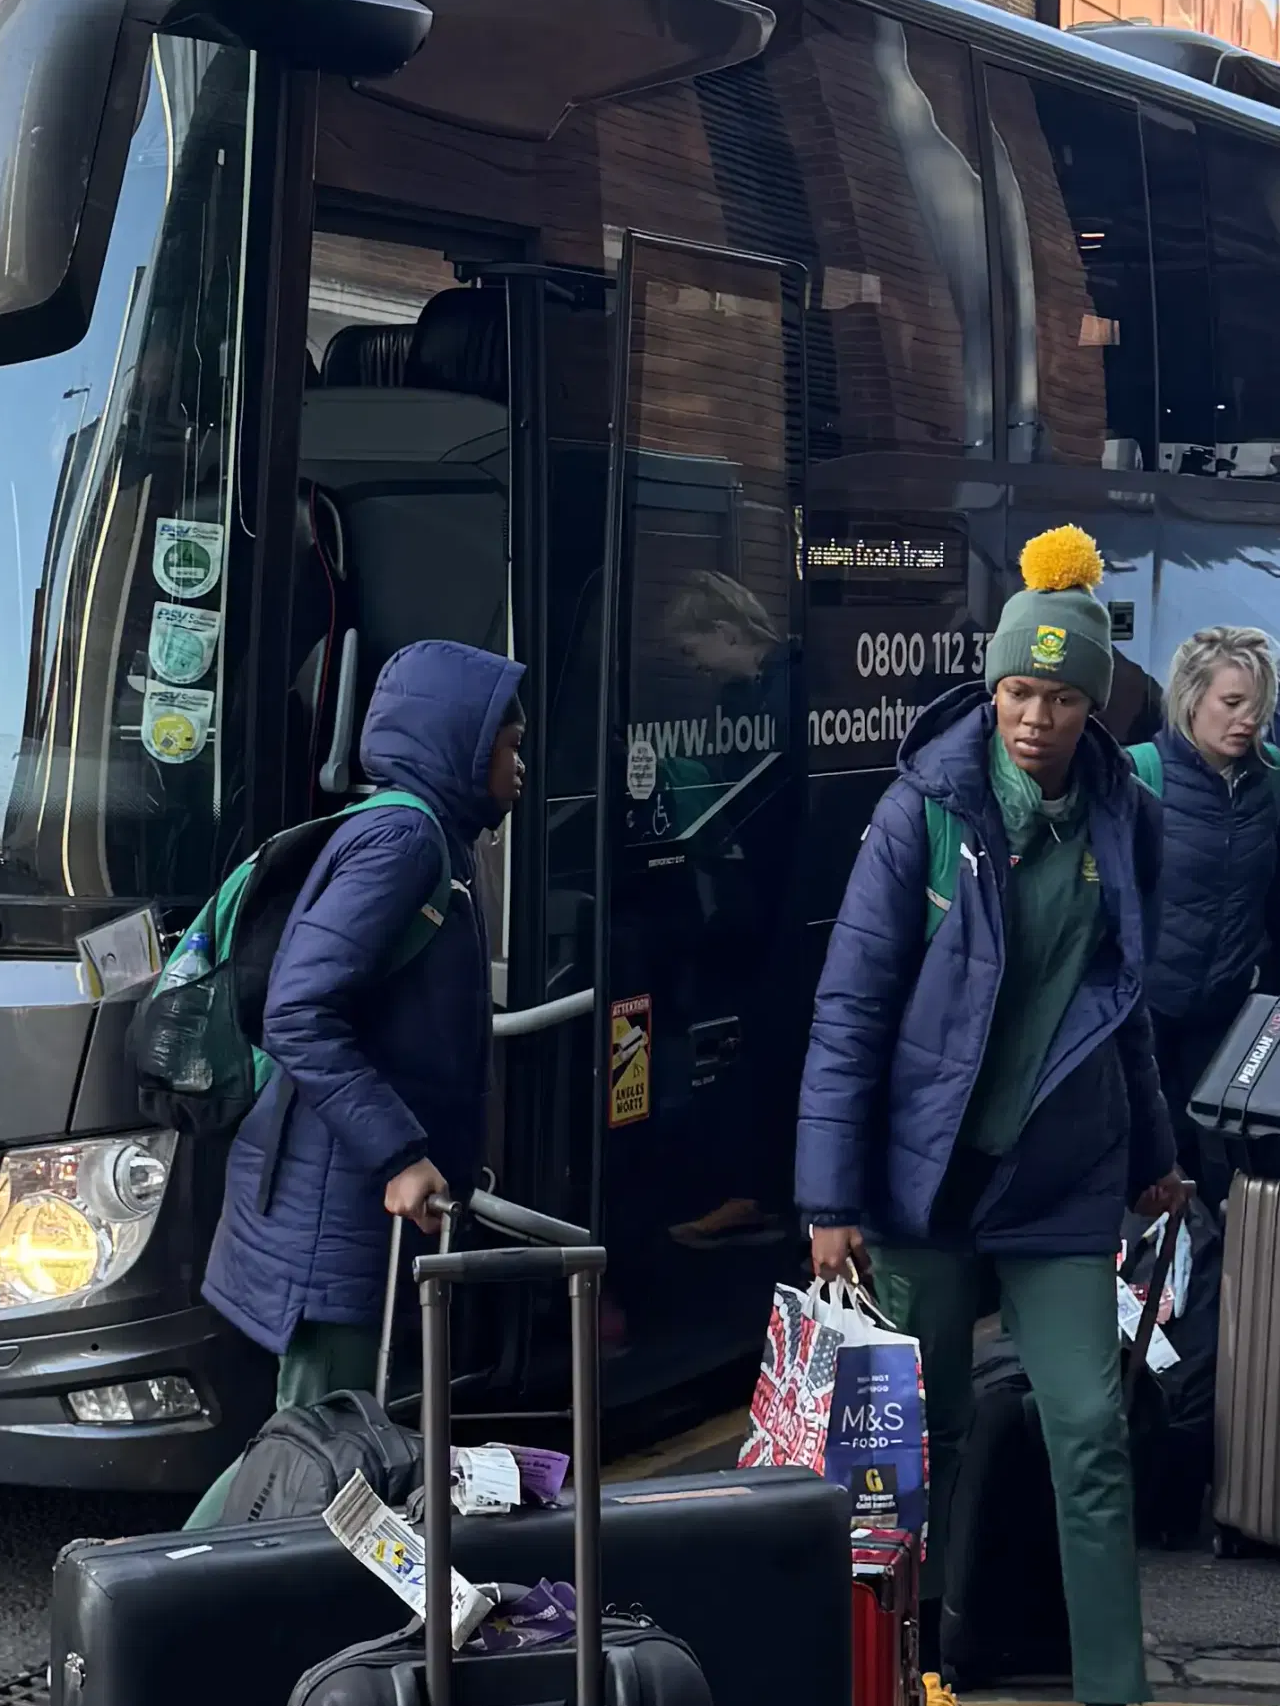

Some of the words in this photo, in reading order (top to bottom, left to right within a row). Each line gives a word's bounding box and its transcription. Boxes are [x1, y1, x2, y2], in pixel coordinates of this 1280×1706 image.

[857, 632, 925, 678] 0800
[932, 632, 965, 674] 112
[1237, 1034, 1274, 1085] PELICAN
[841, 1402, 904, 1433] M&S
